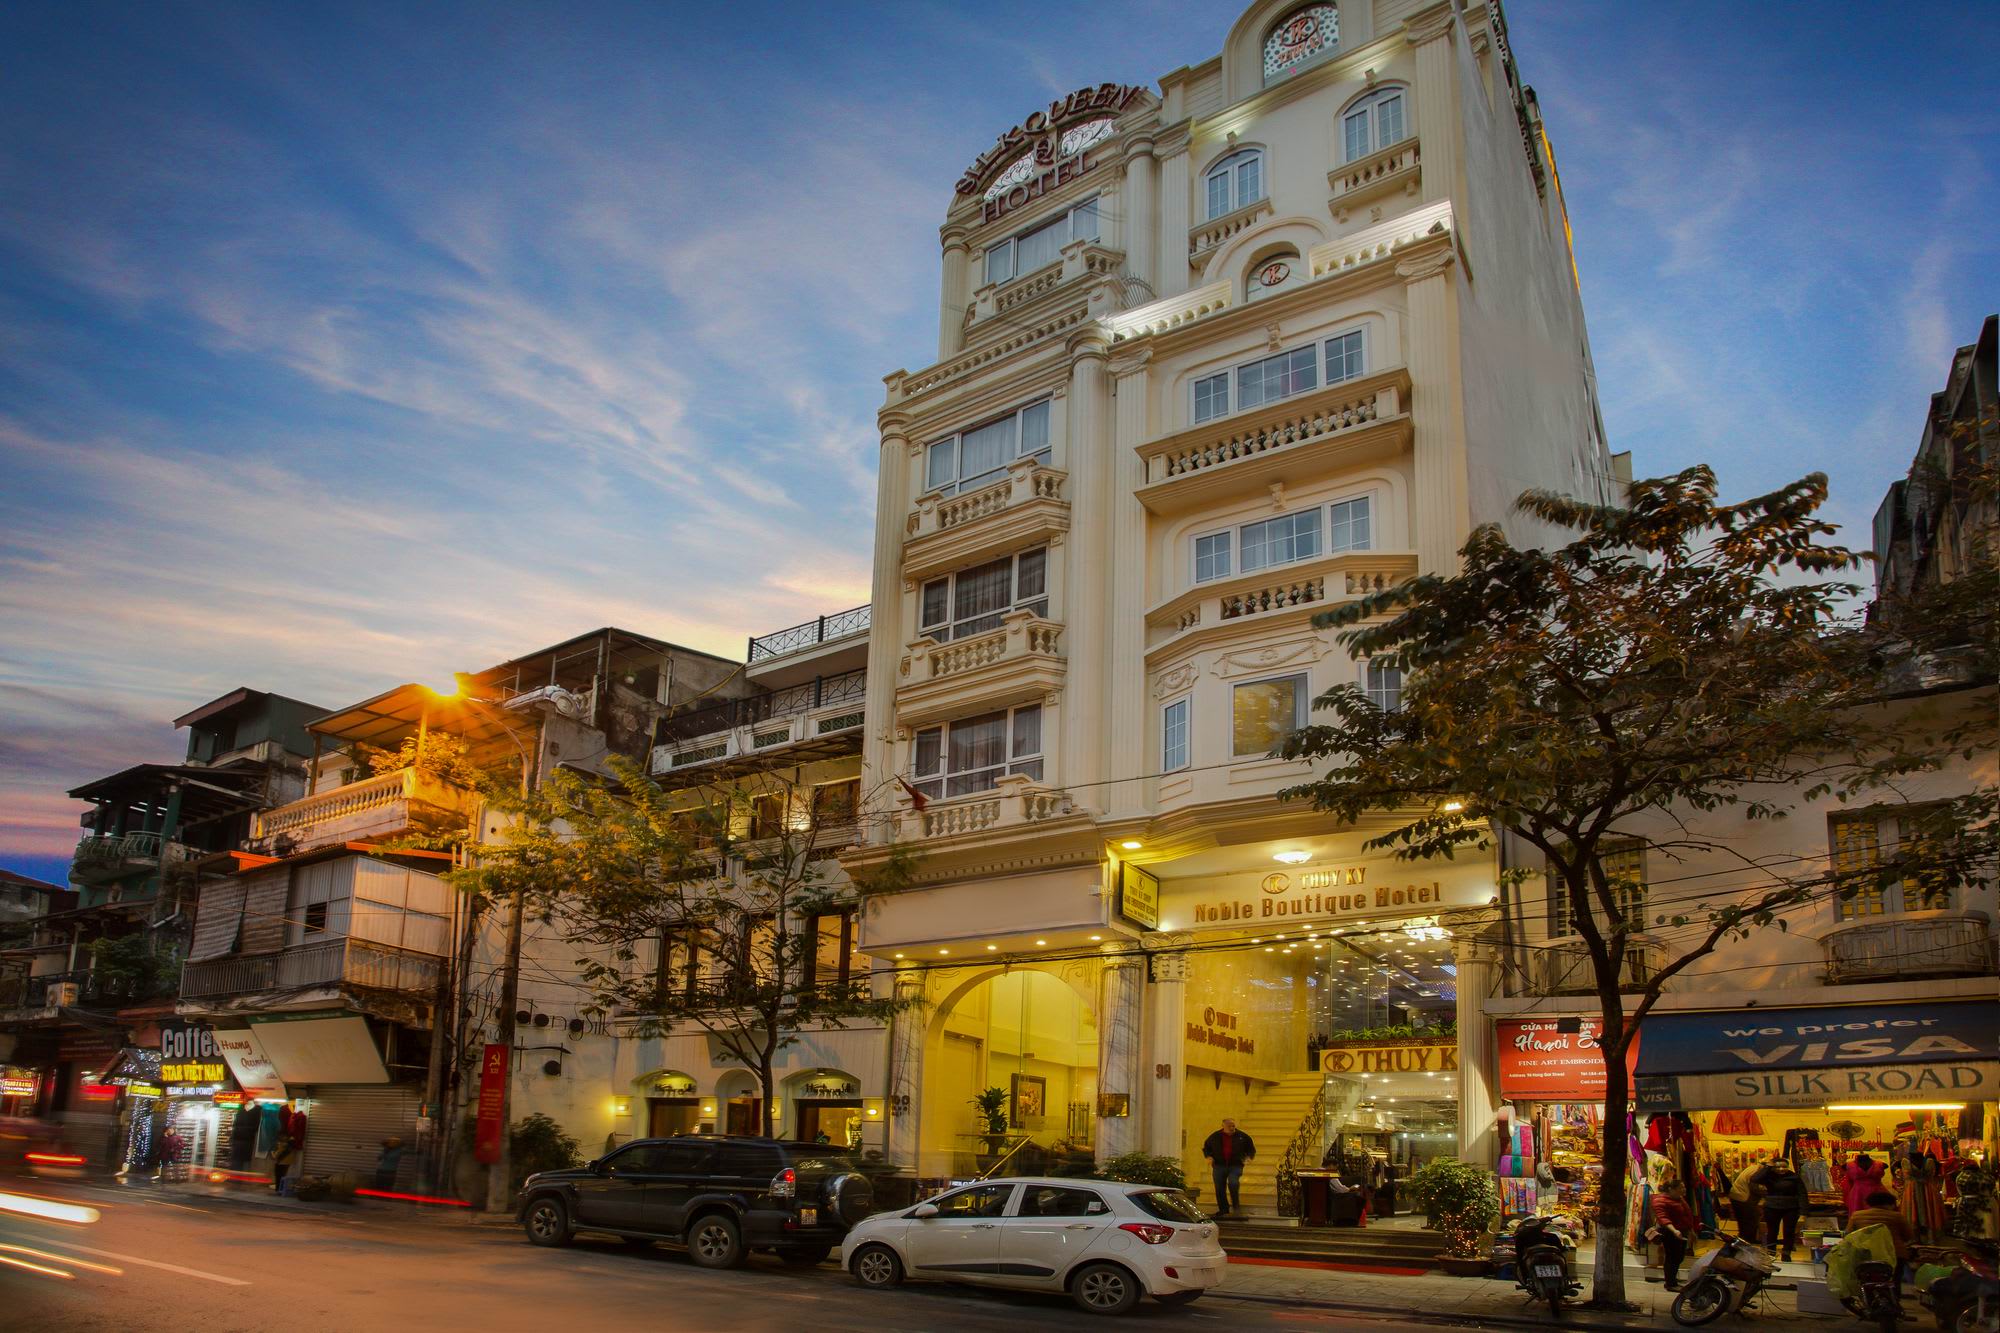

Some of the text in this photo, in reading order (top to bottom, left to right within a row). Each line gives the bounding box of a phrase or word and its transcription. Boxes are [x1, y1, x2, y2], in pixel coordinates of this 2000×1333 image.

[1022, 82, 1148, 135] QUEEN
[980, 150, 1099, 226] HOTEL
[1299, 868, 1342, 890] THUY
[1345, 867, 1367, 886] KY
[1194, 881, 1442, 923] Noble Boutique Hotel
[1723, 1018, 1940, 1037] we prefer
[1514, 1031, 1569, 1053] Hanoi
[1722, 1035, 1980, 1065] VISA
[1357, 1048, 1433, 1072] THUY
[162, 1064, 183, 1082] STAR
[204, 1064, 225, 1082] NAM
[1734, 1065, 1984, 1098] SILK ROAD
[1641, 1094, 1673, 1103] VISA
